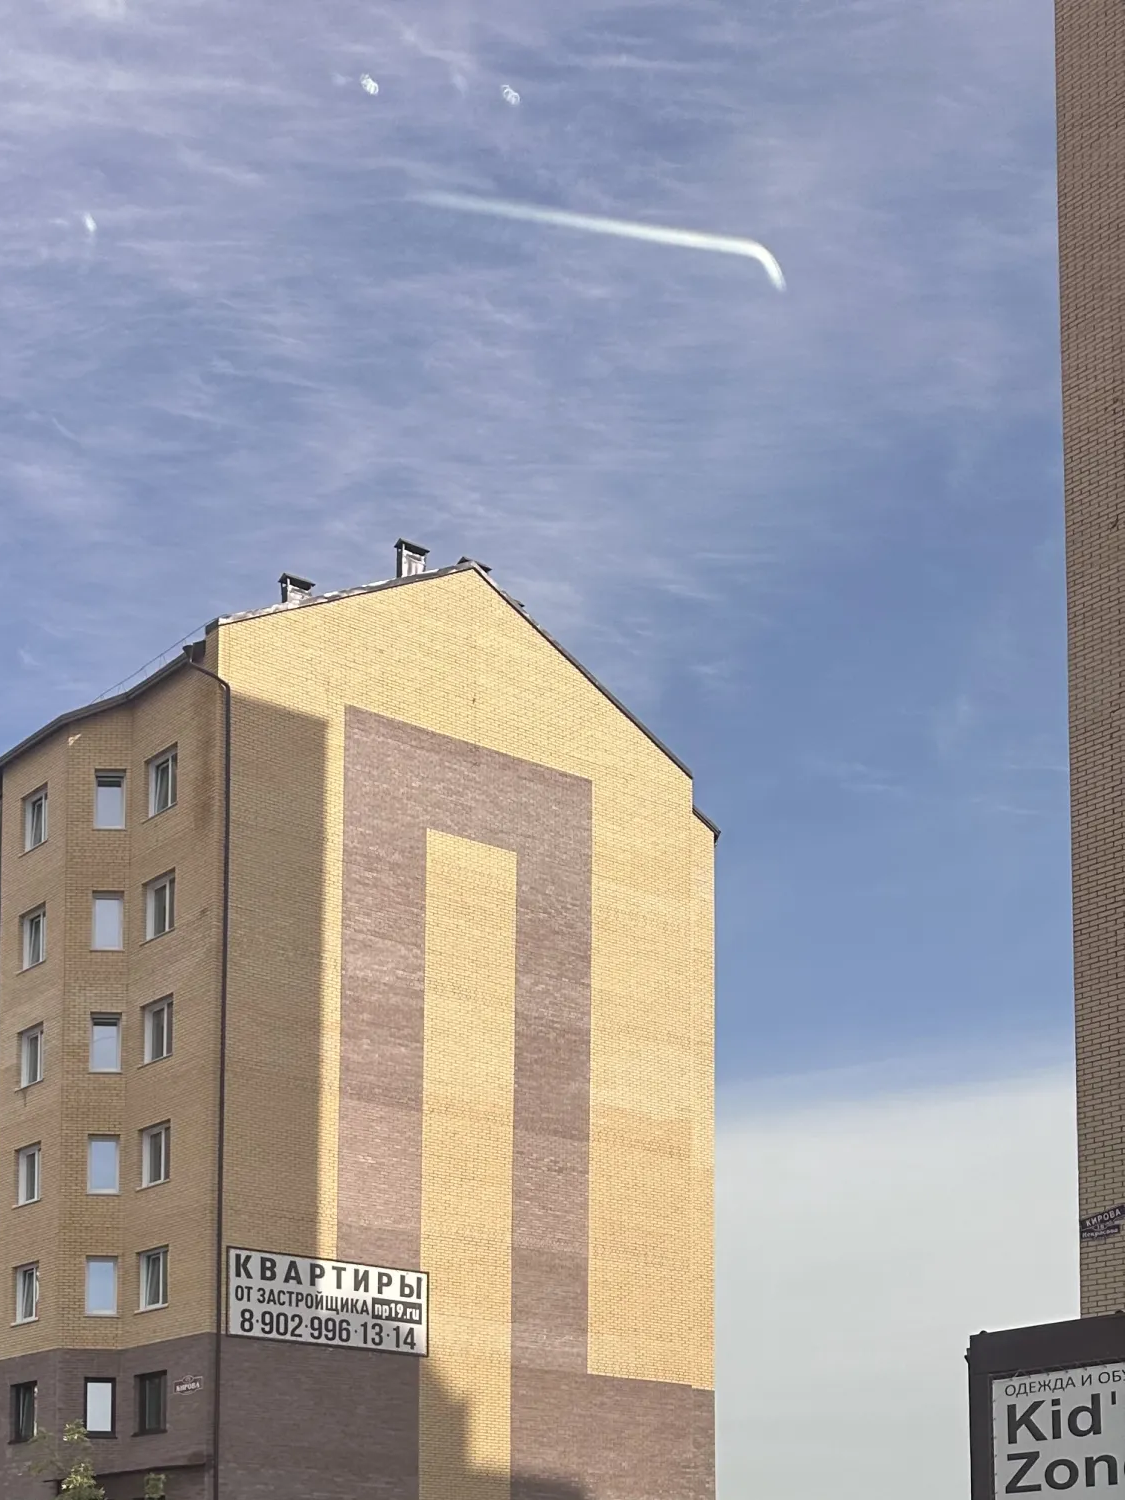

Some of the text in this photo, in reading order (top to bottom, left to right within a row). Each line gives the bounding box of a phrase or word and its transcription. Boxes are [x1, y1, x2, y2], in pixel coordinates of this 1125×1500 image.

[1086, 1208, 1121, 1227] КИРОВА
[235, 1253, 423, 1300] КВАРТИРЫ
[235, 1285, 370, 1315] ОТ ЗАСТРОЙЩИКА
[175, 1381, 200, 1392] КИРОВА
[1004, 1369, 1125, 1398] ОДЕЖДА И ОБ
[1005, 1450, 1125, 1494] Zon
